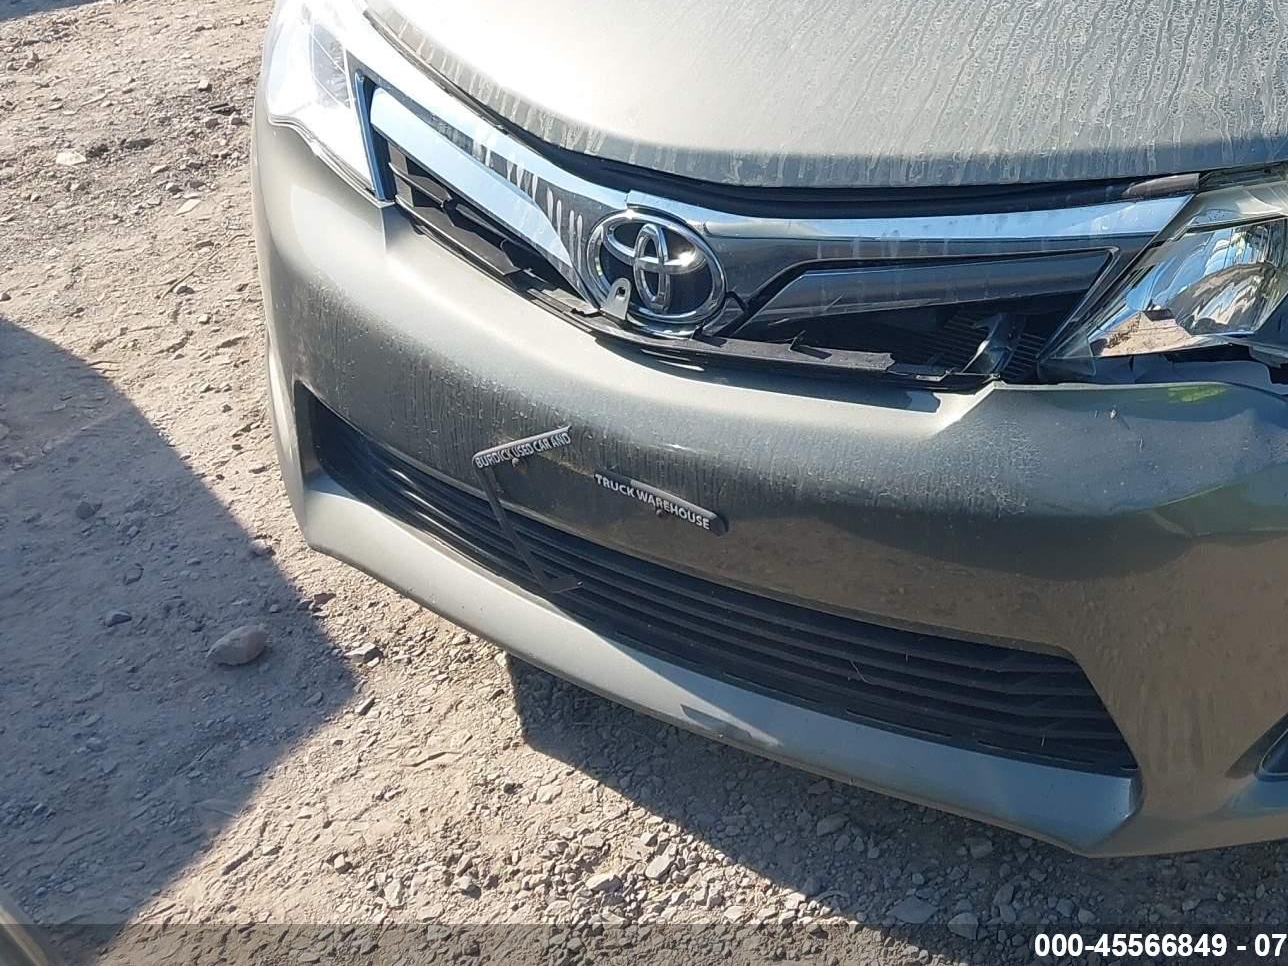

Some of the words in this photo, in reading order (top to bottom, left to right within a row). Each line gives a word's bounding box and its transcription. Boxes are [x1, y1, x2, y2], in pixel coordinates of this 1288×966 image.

[475, 448, 513, 470] BURDICK
[512, 442, 533, 460] USED
[533, 438, 551, 453] CAR
[550, 432, 571, 448] AND
[595, 473, 636, 498] TRUCK
[636, 488, 711, 530] WAREHOUSE
